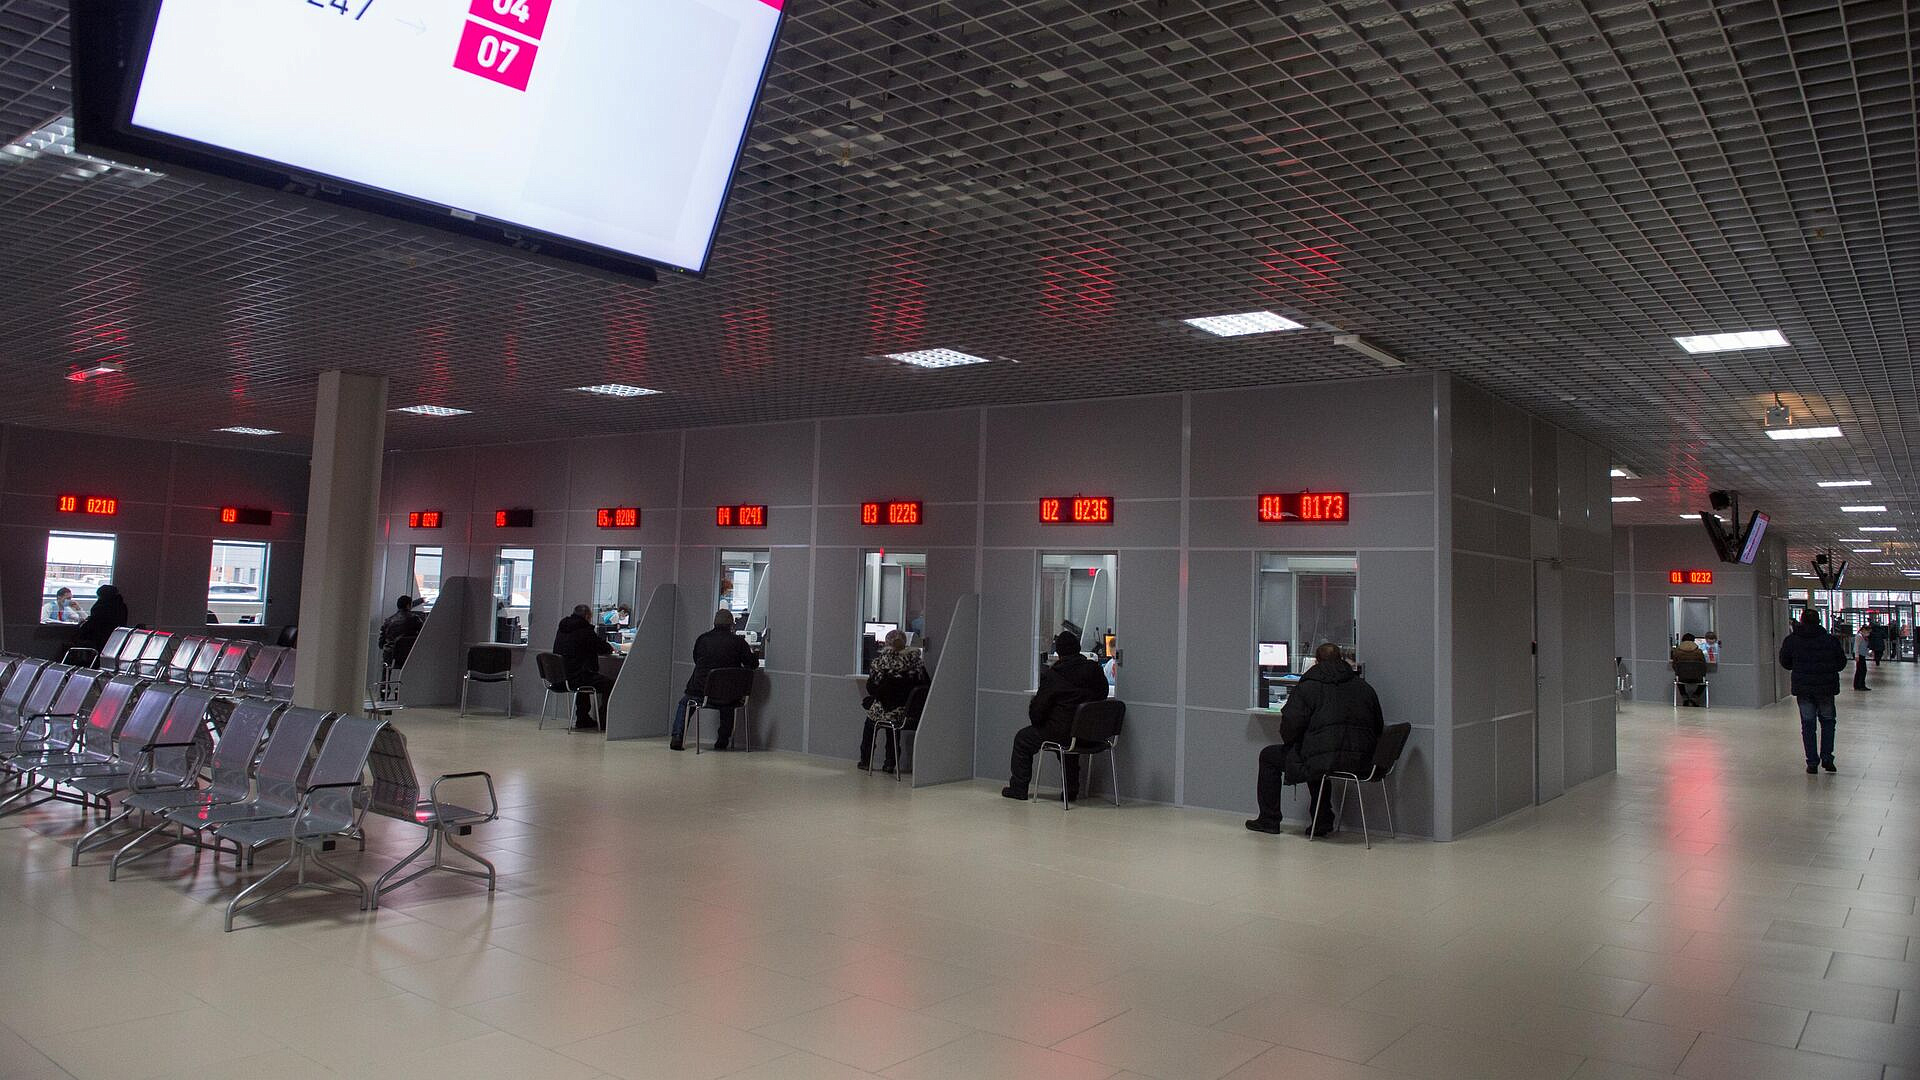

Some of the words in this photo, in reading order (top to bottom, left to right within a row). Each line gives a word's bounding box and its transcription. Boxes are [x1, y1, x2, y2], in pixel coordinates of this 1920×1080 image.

[477, 35, 520, 73] 07
[60, 496, 75, 512] 10
[87, 498, 115, 514] 0210
[863, 504, 877, 524] 03
[889, 503, 917, 523] 0226
[1042, 499, 1060, 521] 02
[1074, 498, 1108, 521] 0236
[1263, 496, 1282, 520] 01
[1302, 495, 1343, 519] 0173
[616, 509, 636, 526] 0209
[718, 507, 730, 526] 04
[739, 506, 763, 525] 0241
[1671, 571, 1683, 583] 01
[1691, 571, 1712, 583] 0232
